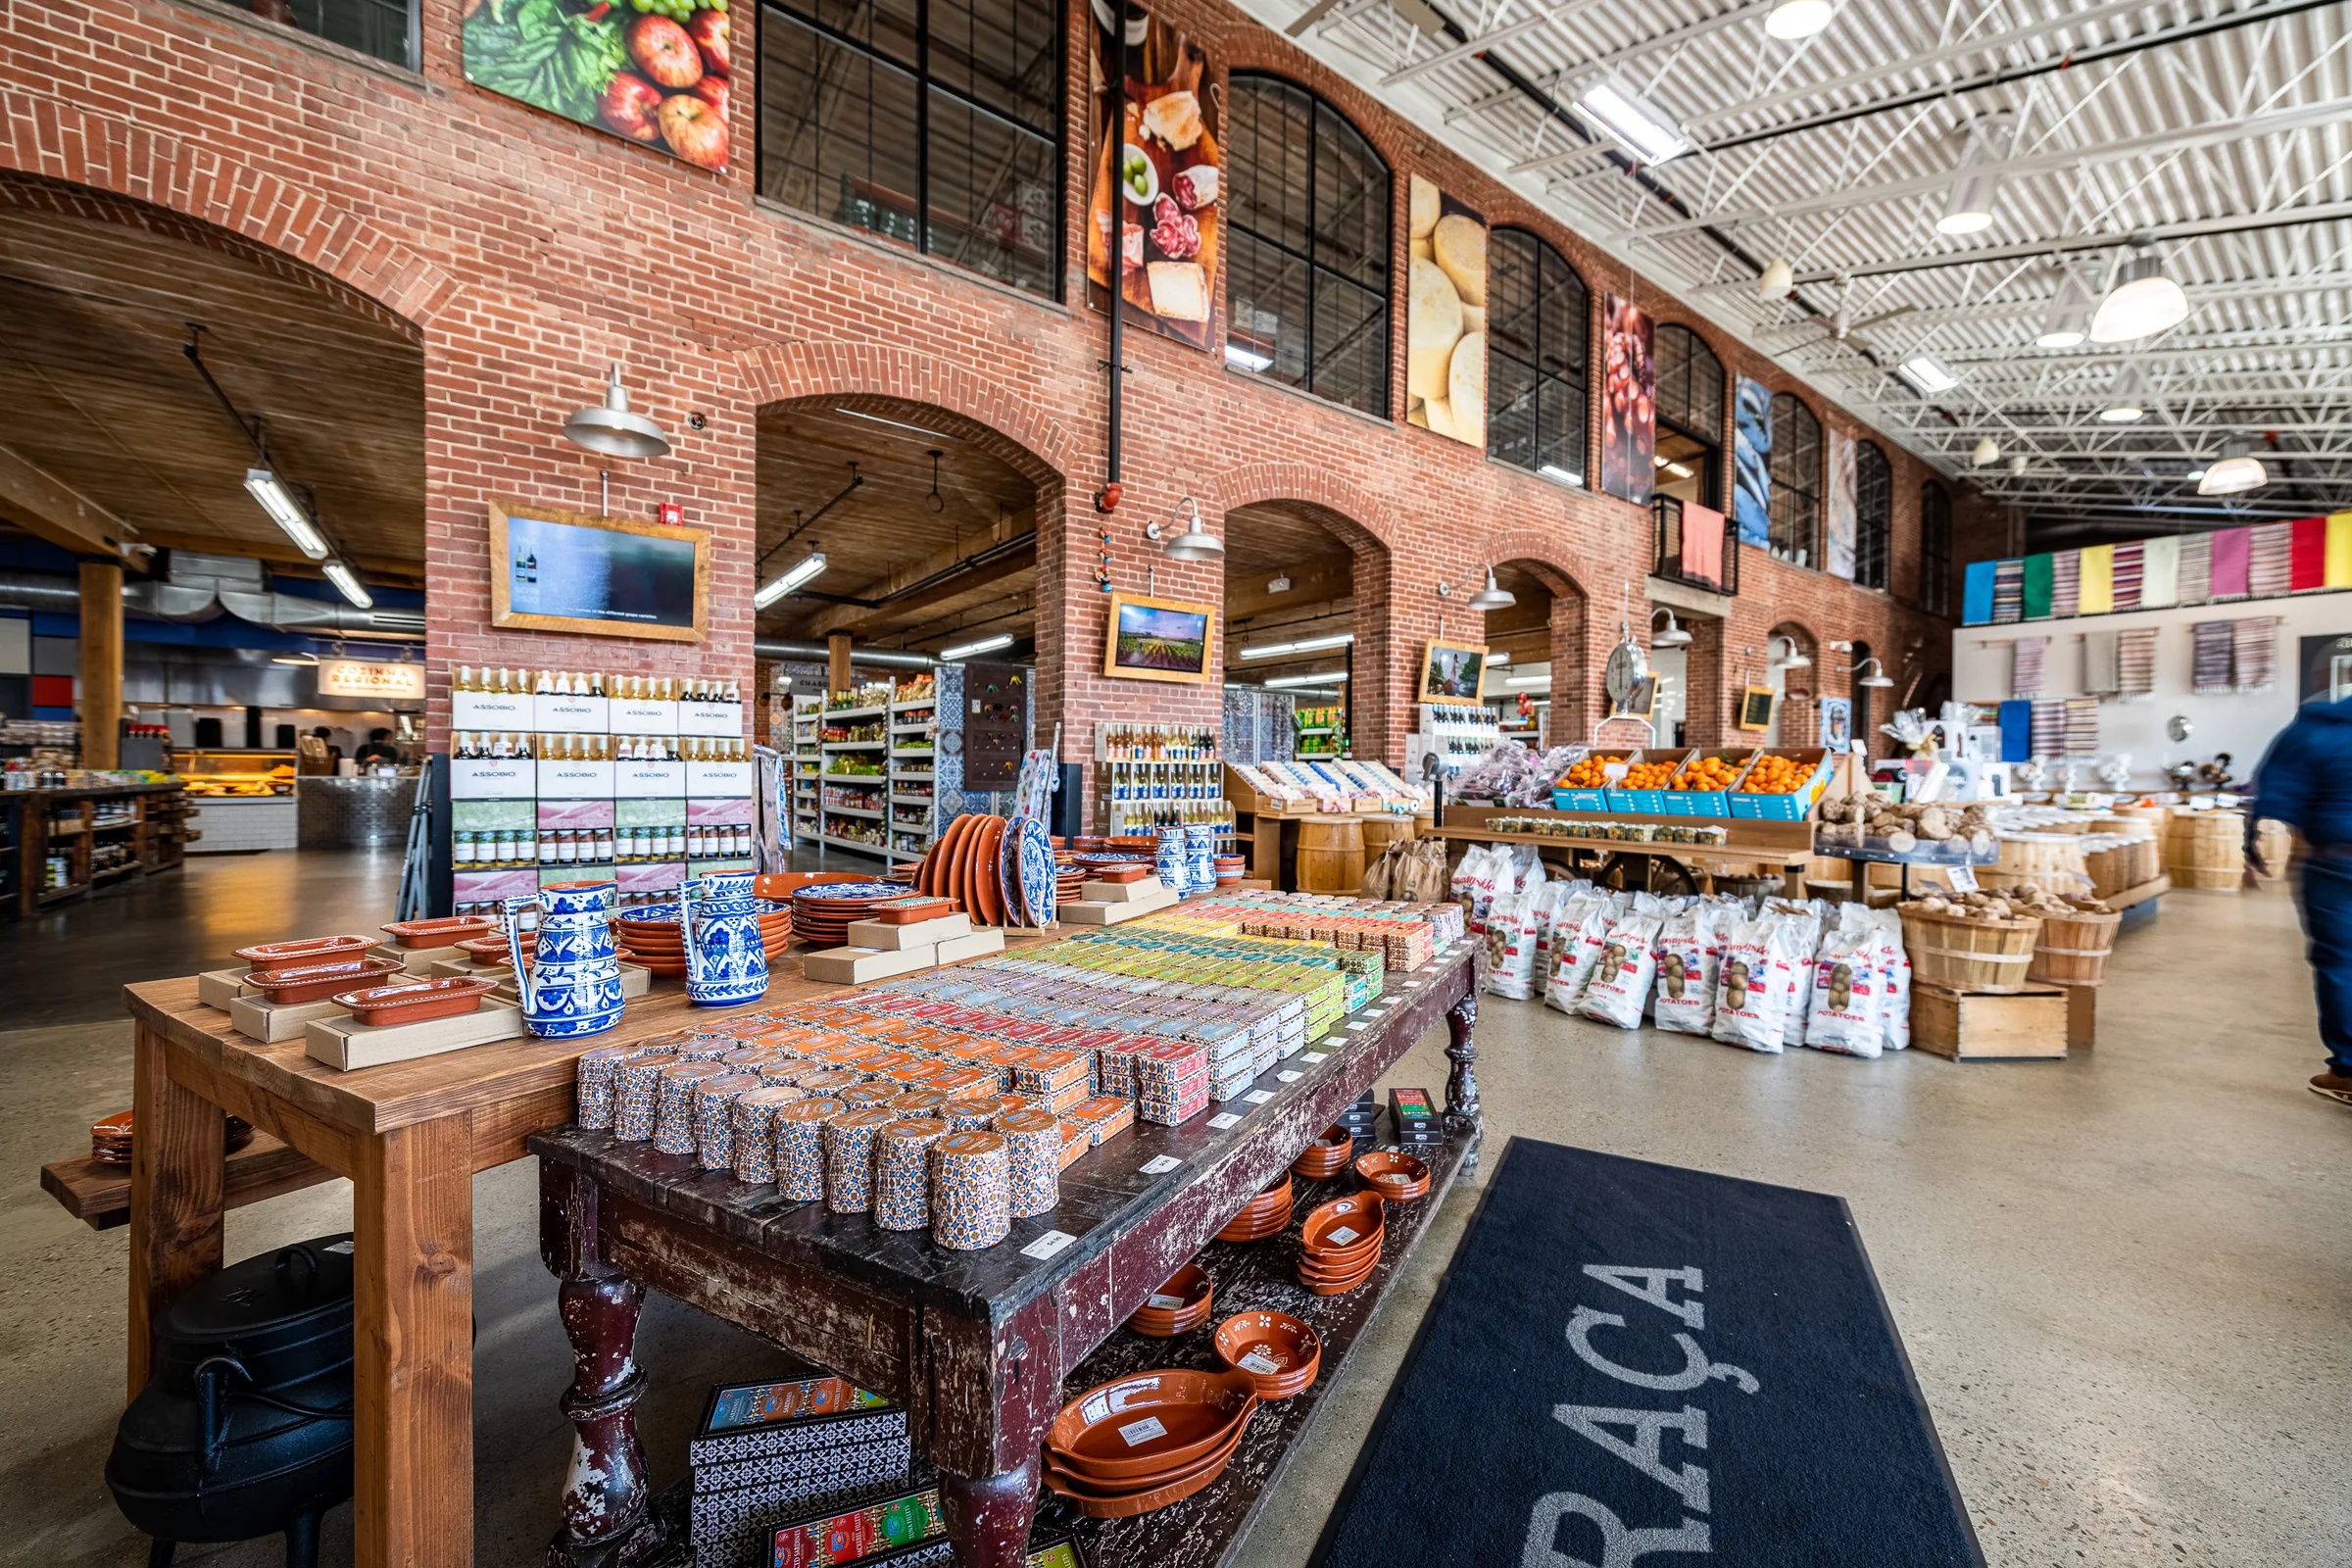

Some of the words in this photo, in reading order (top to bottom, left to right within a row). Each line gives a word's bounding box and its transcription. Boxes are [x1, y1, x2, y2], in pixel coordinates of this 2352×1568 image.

[337, 665, 408, 677] COZINHA
[331, 674, 414, 687] REGIONAL
[783, 1391, 793, 1413] SARDINES
